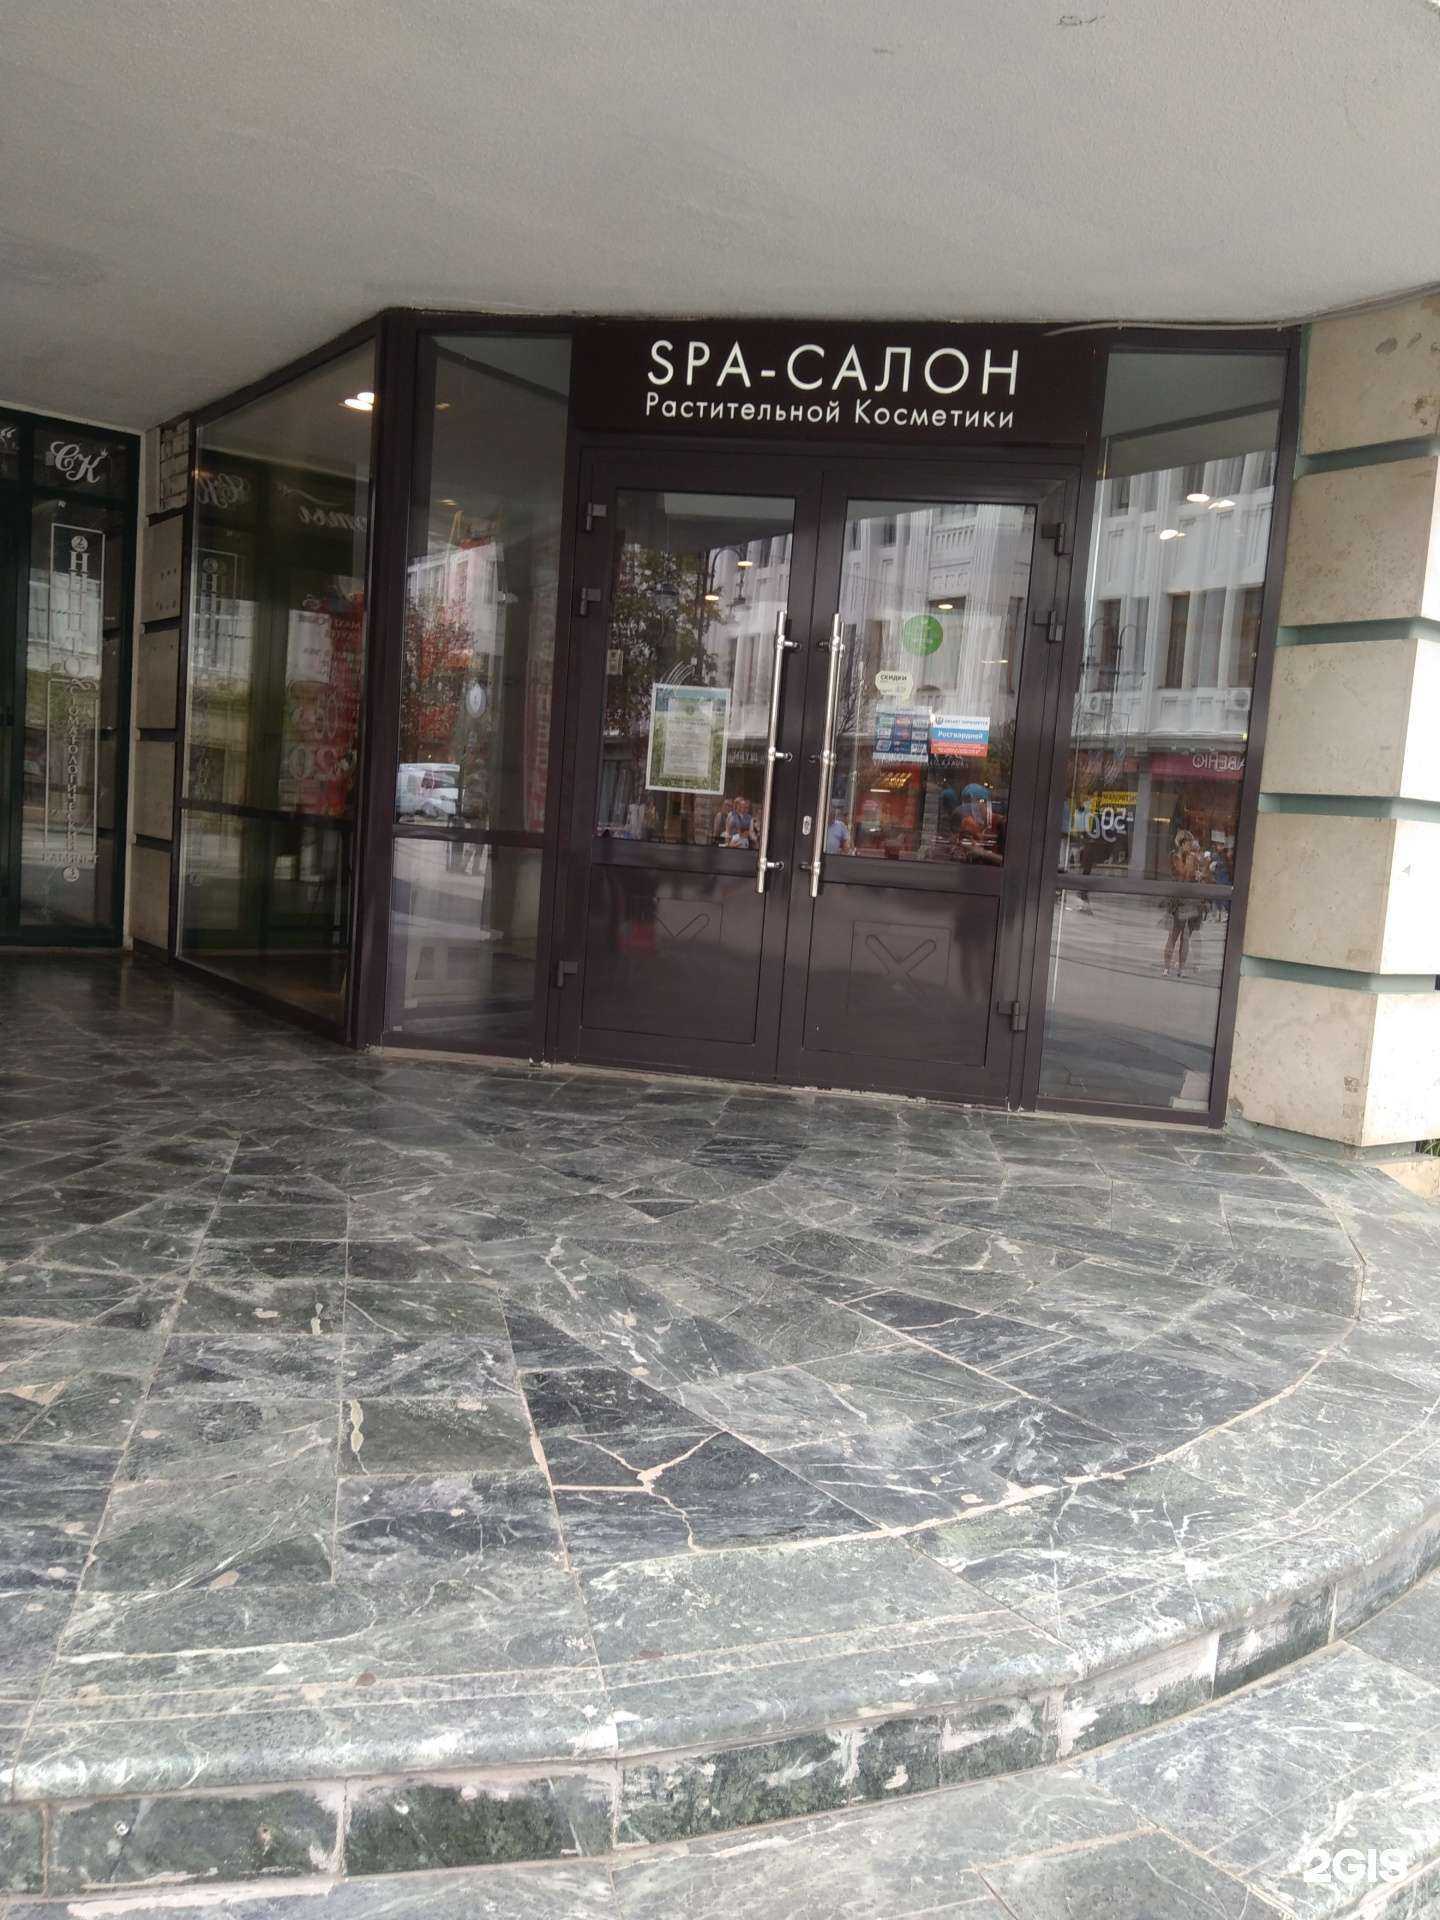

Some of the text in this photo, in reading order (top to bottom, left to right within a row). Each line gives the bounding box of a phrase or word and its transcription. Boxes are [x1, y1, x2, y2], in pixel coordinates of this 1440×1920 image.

[646, 338, 1020, 396] SPA-САЛОН
[644, 390, 1015, 430] Растительной Косметики
